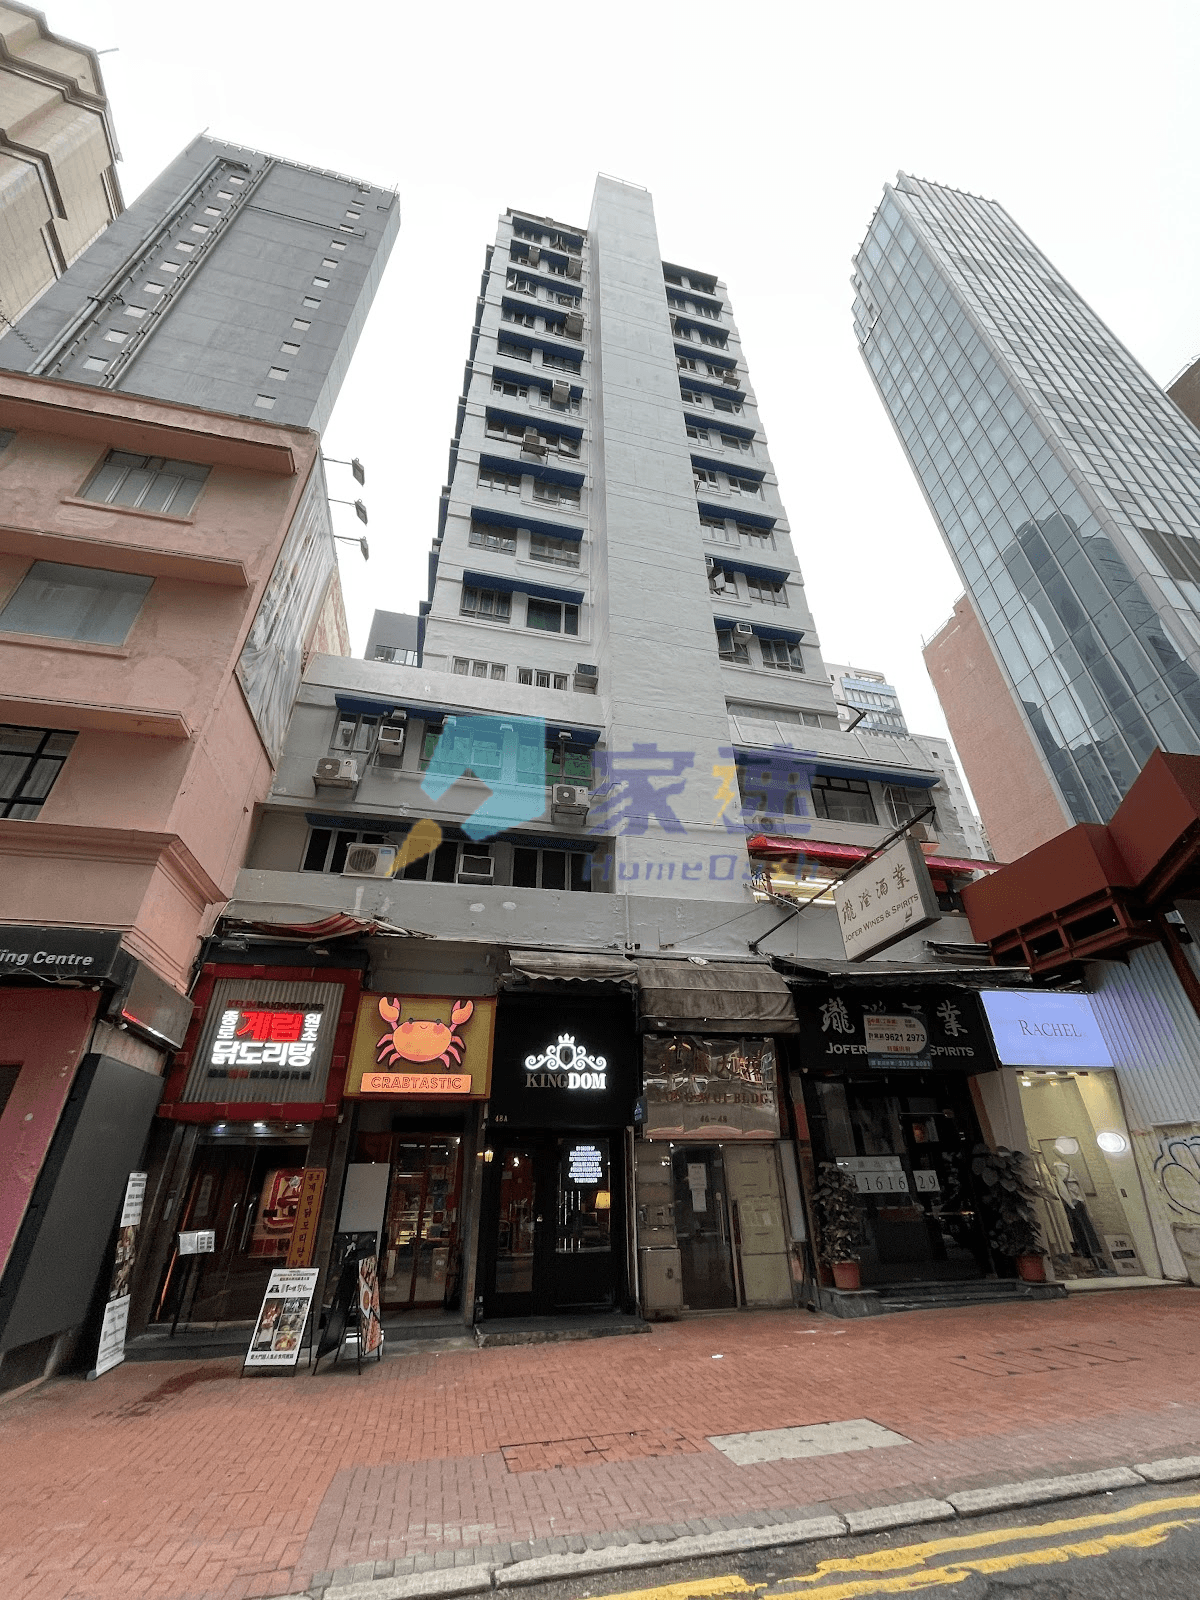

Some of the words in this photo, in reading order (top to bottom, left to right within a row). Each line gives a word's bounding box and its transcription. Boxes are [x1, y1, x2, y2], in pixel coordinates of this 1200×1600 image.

[863, 915, 885, 931] WINES
[885, 910, 891, 918] &
[891, 893, 919, 914] SPIRITS
[33, 951, 93, 966] Centre
[217, 1010, 239, 1039] 종로
[237, 1011, 304, 1042] 계림
[300, 1013, 322, 1041] 원조
[1018, 1019, 1082, 1037] RACHEL
[906, 1034, 925, 1042] 2973
[211, 1041, 316, 1067] 닭도리탕
[826, 1042, 868, 1055] JOFER
[930, 1044, 974, 1057] SPIRITS
[371, 1076, 462, 1090] CRABTASTIC
[525, 1072, 606, 1089] KINGDOM
